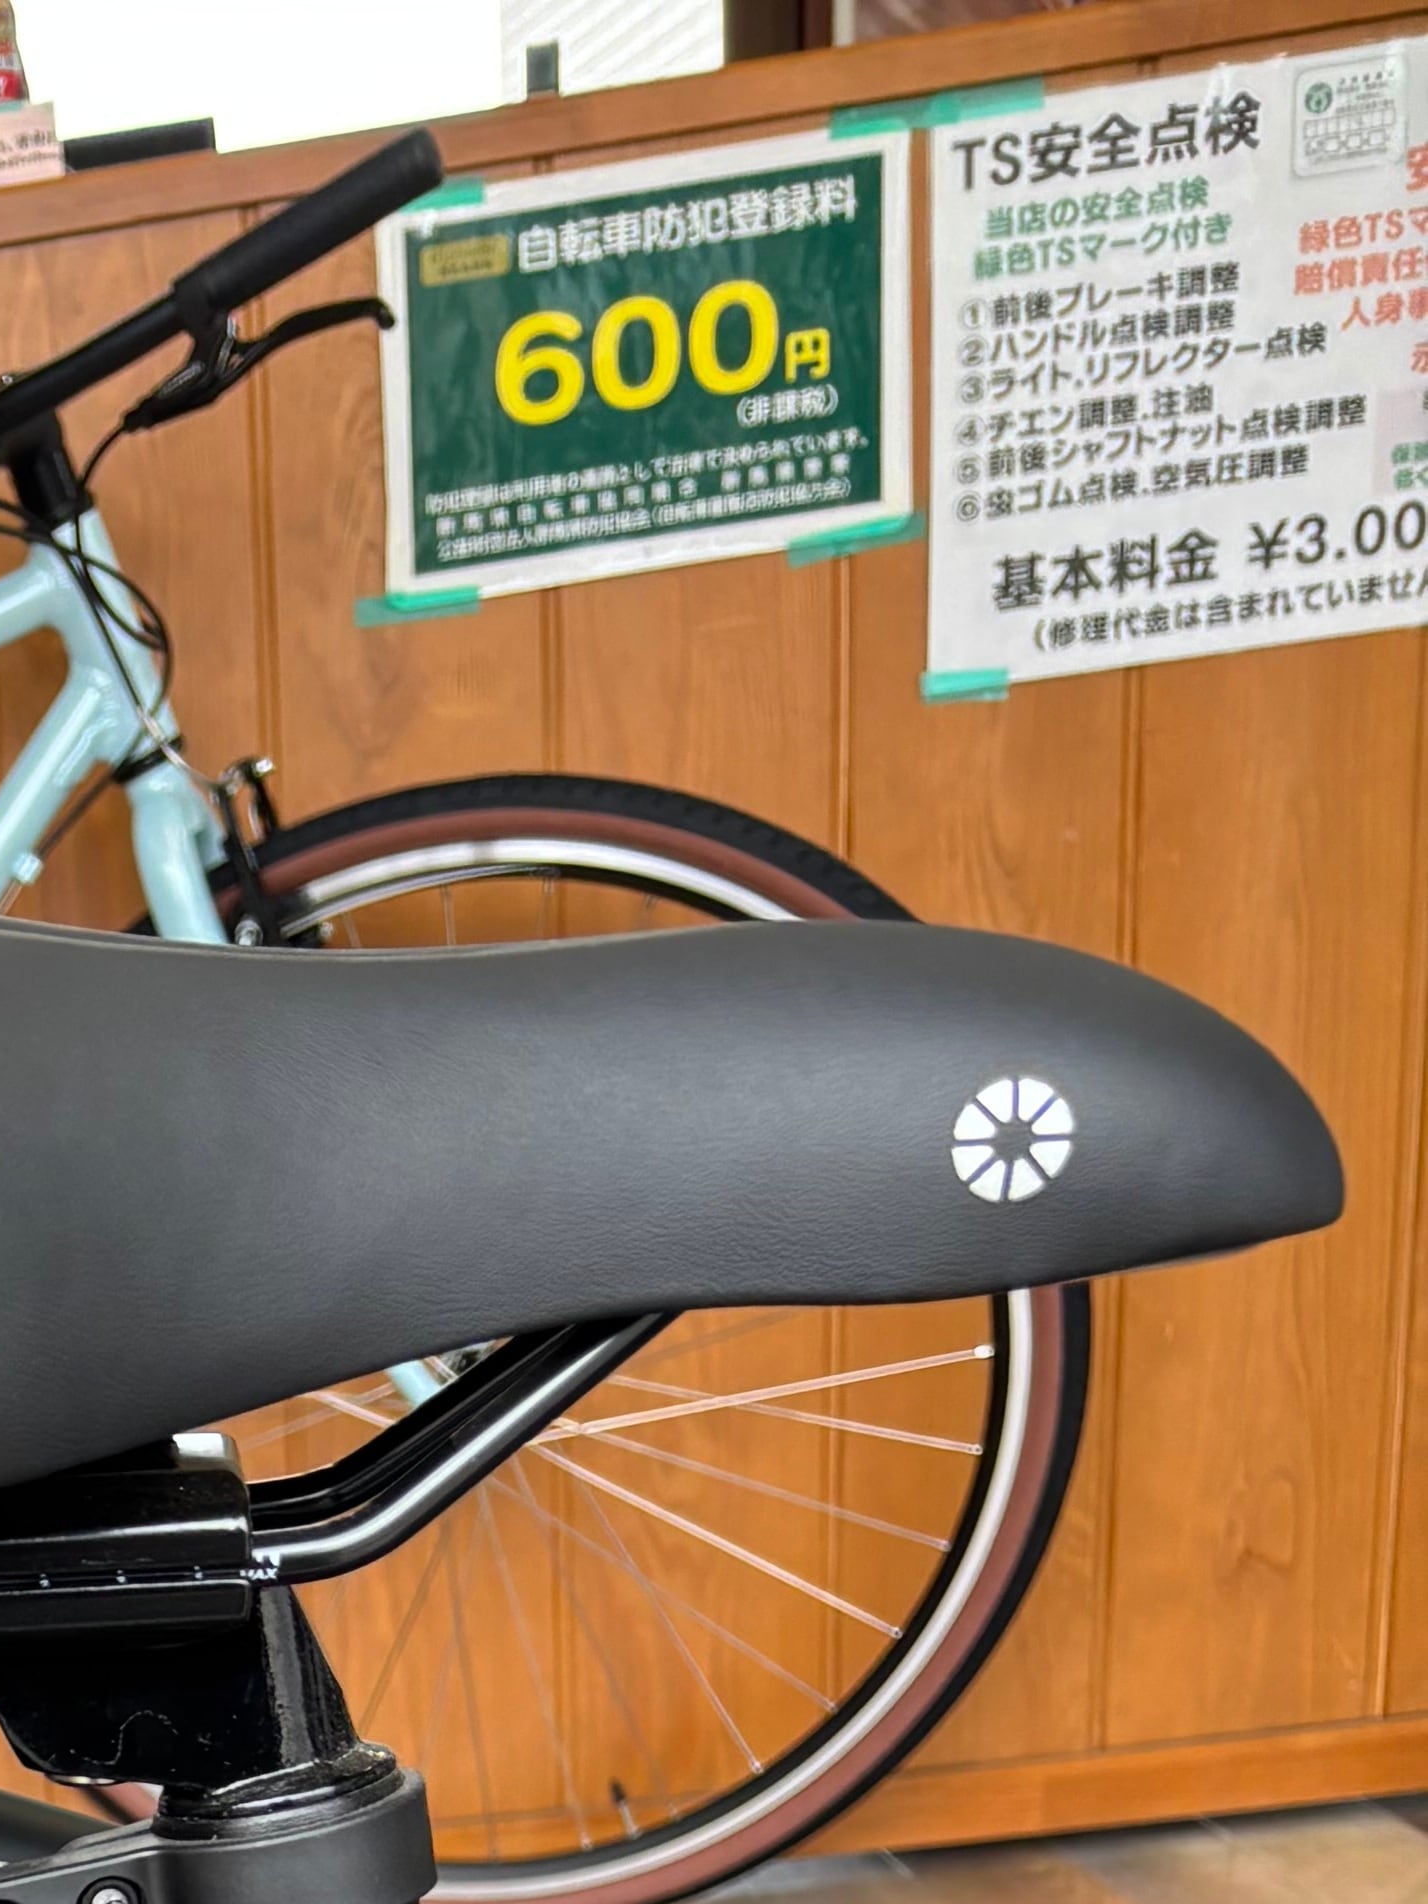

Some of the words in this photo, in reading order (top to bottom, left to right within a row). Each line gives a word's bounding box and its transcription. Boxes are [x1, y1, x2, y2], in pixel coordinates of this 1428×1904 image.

[953, 89, 1262, 190] TS安全点検
[517, 174, 858, 275] 自転車防犯登録料
[973, 213, 1233, 281] 緑色TSマーク付き
[986, 174, 1209, 238] 当店の安全点検
[993, 526, 1219, 613] 基本料金
